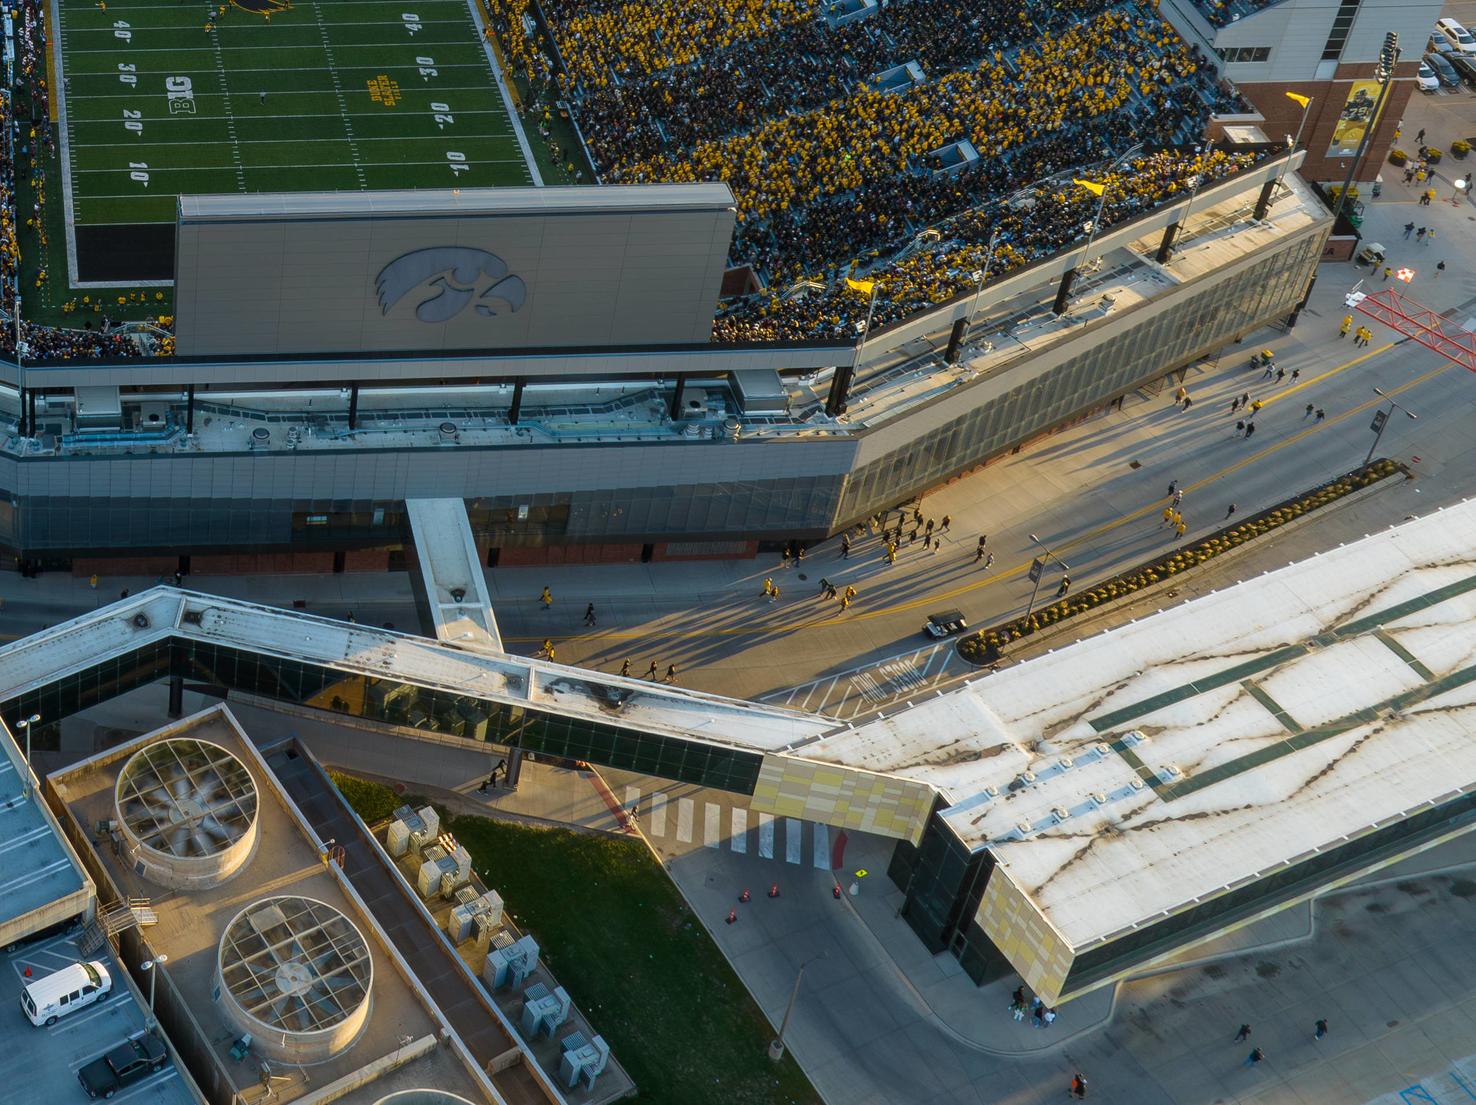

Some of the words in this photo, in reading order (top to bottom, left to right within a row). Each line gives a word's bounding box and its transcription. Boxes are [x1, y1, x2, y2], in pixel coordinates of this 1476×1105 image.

[113, 20, 131, 39] 40
[402, 13, 422, 31] 40
[118, 63, 137, 82] 30
[416, 56, 438, 76] 30
[366, 79, 382, 102] DUKE
[377, 75, 396, 106] SLATER
[123, 109, 143, 131] 20
[430, 102, 454, 123] 20
[1349, 107, 1367, 115] 79
[446, 151, 470, 170] 10
[129, 162, 149, 181] 10
